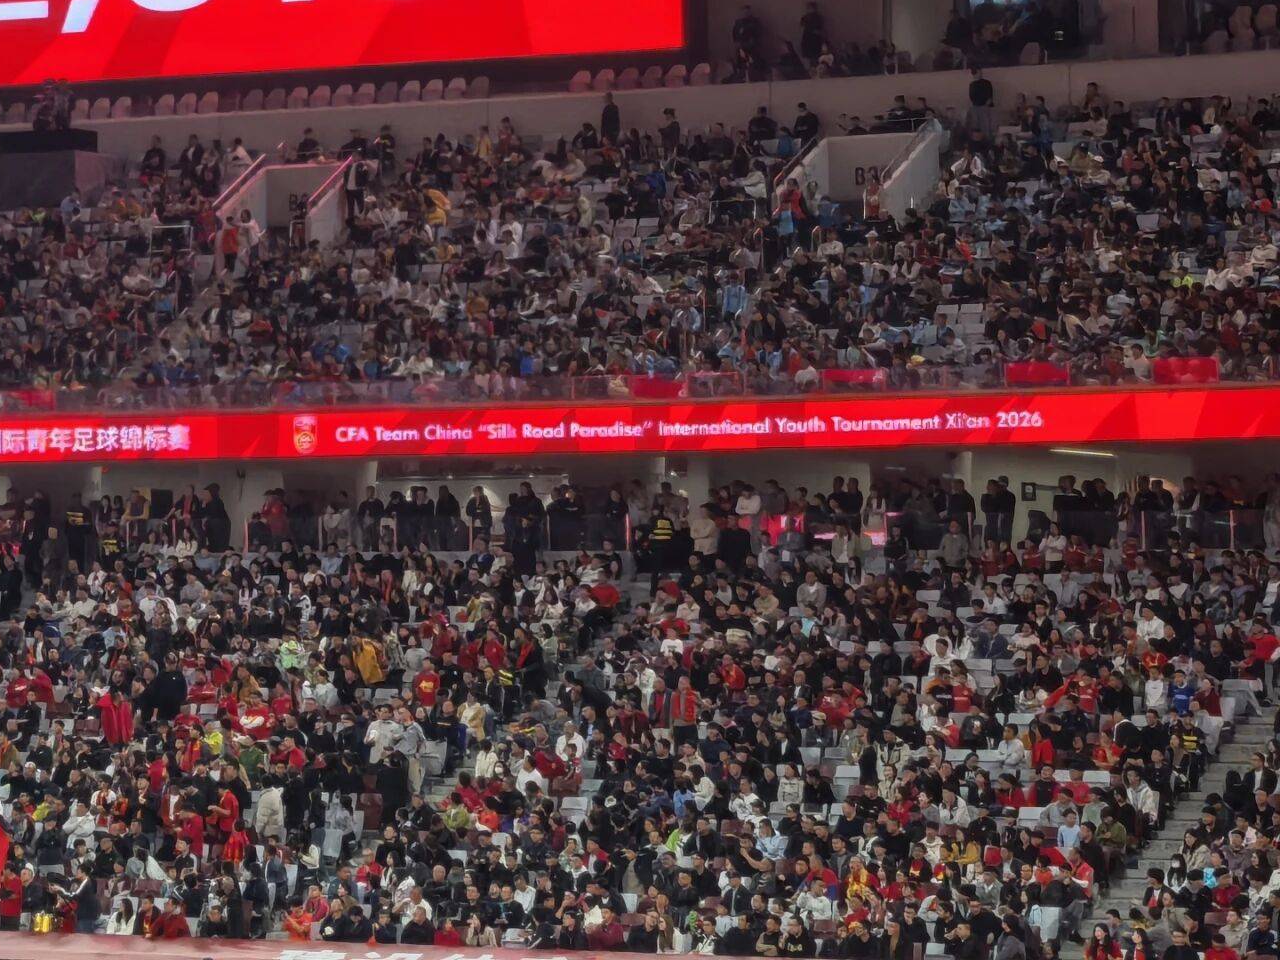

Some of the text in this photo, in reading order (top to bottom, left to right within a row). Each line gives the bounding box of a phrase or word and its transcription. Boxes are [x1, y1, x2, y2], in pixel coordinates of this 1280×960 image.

[335, 426, 369, 443] CFA
[375, 426, 419, 442] Team
[424, 424, 472, 440] China
[523, 422, 564, 438] Road
[658, 418, 770, 436] International
[775, 416, 825, 432] Youth
[831, 415, 940, 431] Tournament
[997, 411, 1042, 427] 2026
